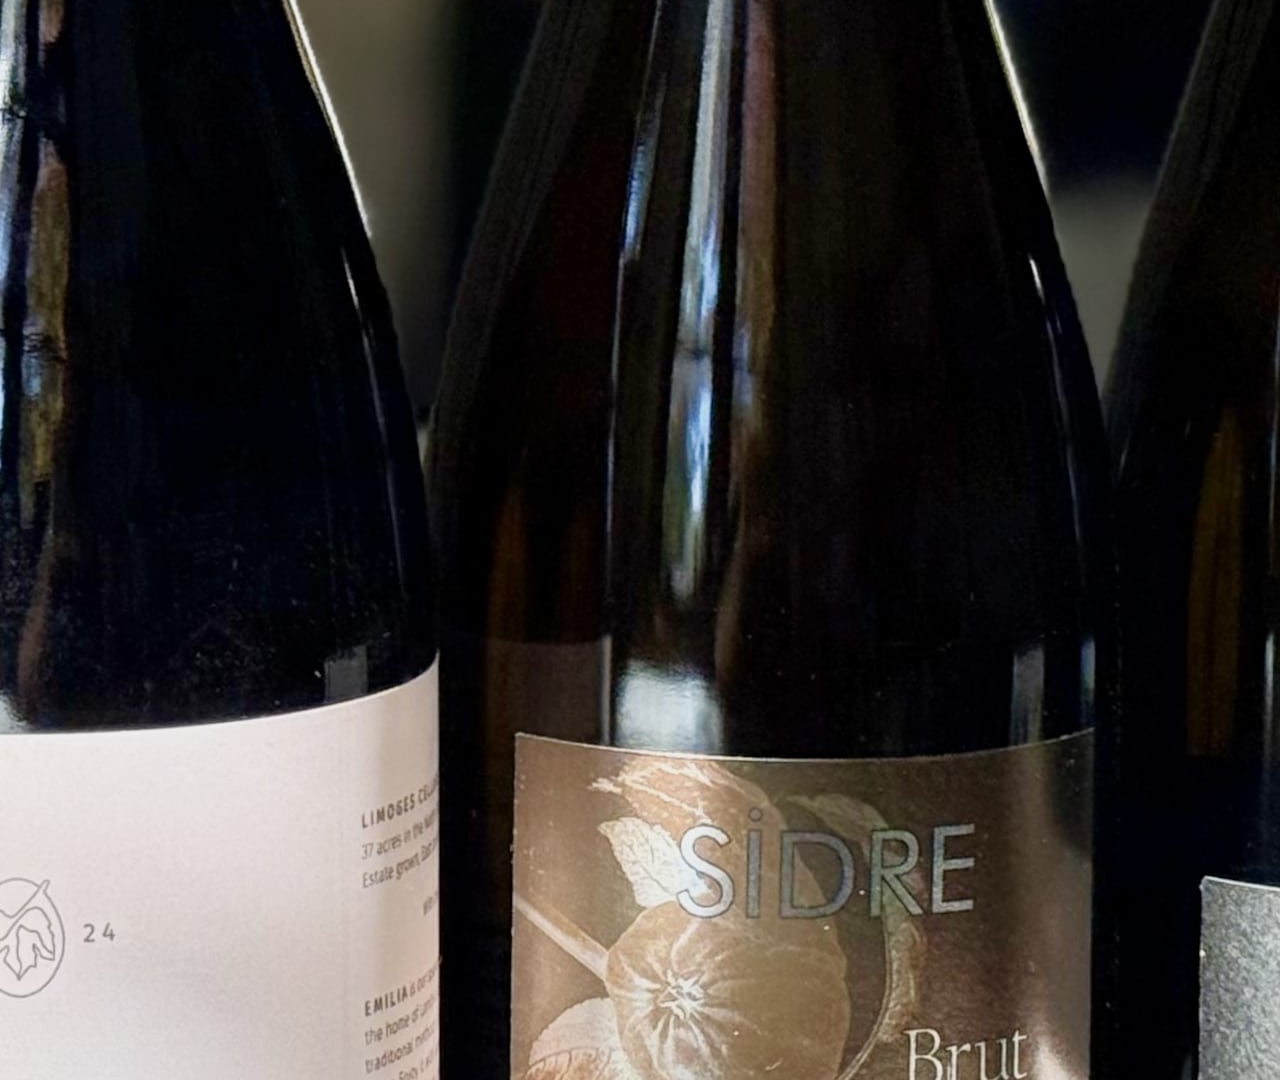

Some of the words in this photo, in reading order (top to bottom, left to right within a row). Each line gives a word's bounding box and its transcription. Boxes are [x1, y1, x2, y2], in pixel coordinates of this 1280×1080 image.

[362, 793, 415, 829] LIMOGES
[363, 866, 394, 888] Estate
[83, 922, 116, 943] 24
[364, 985, 408, 1017] EMILIA
[364, 1027, 384, 1046] the
[385, 1014, 410, 1039] home
[904, 1029, 1028, 1080] Brut
